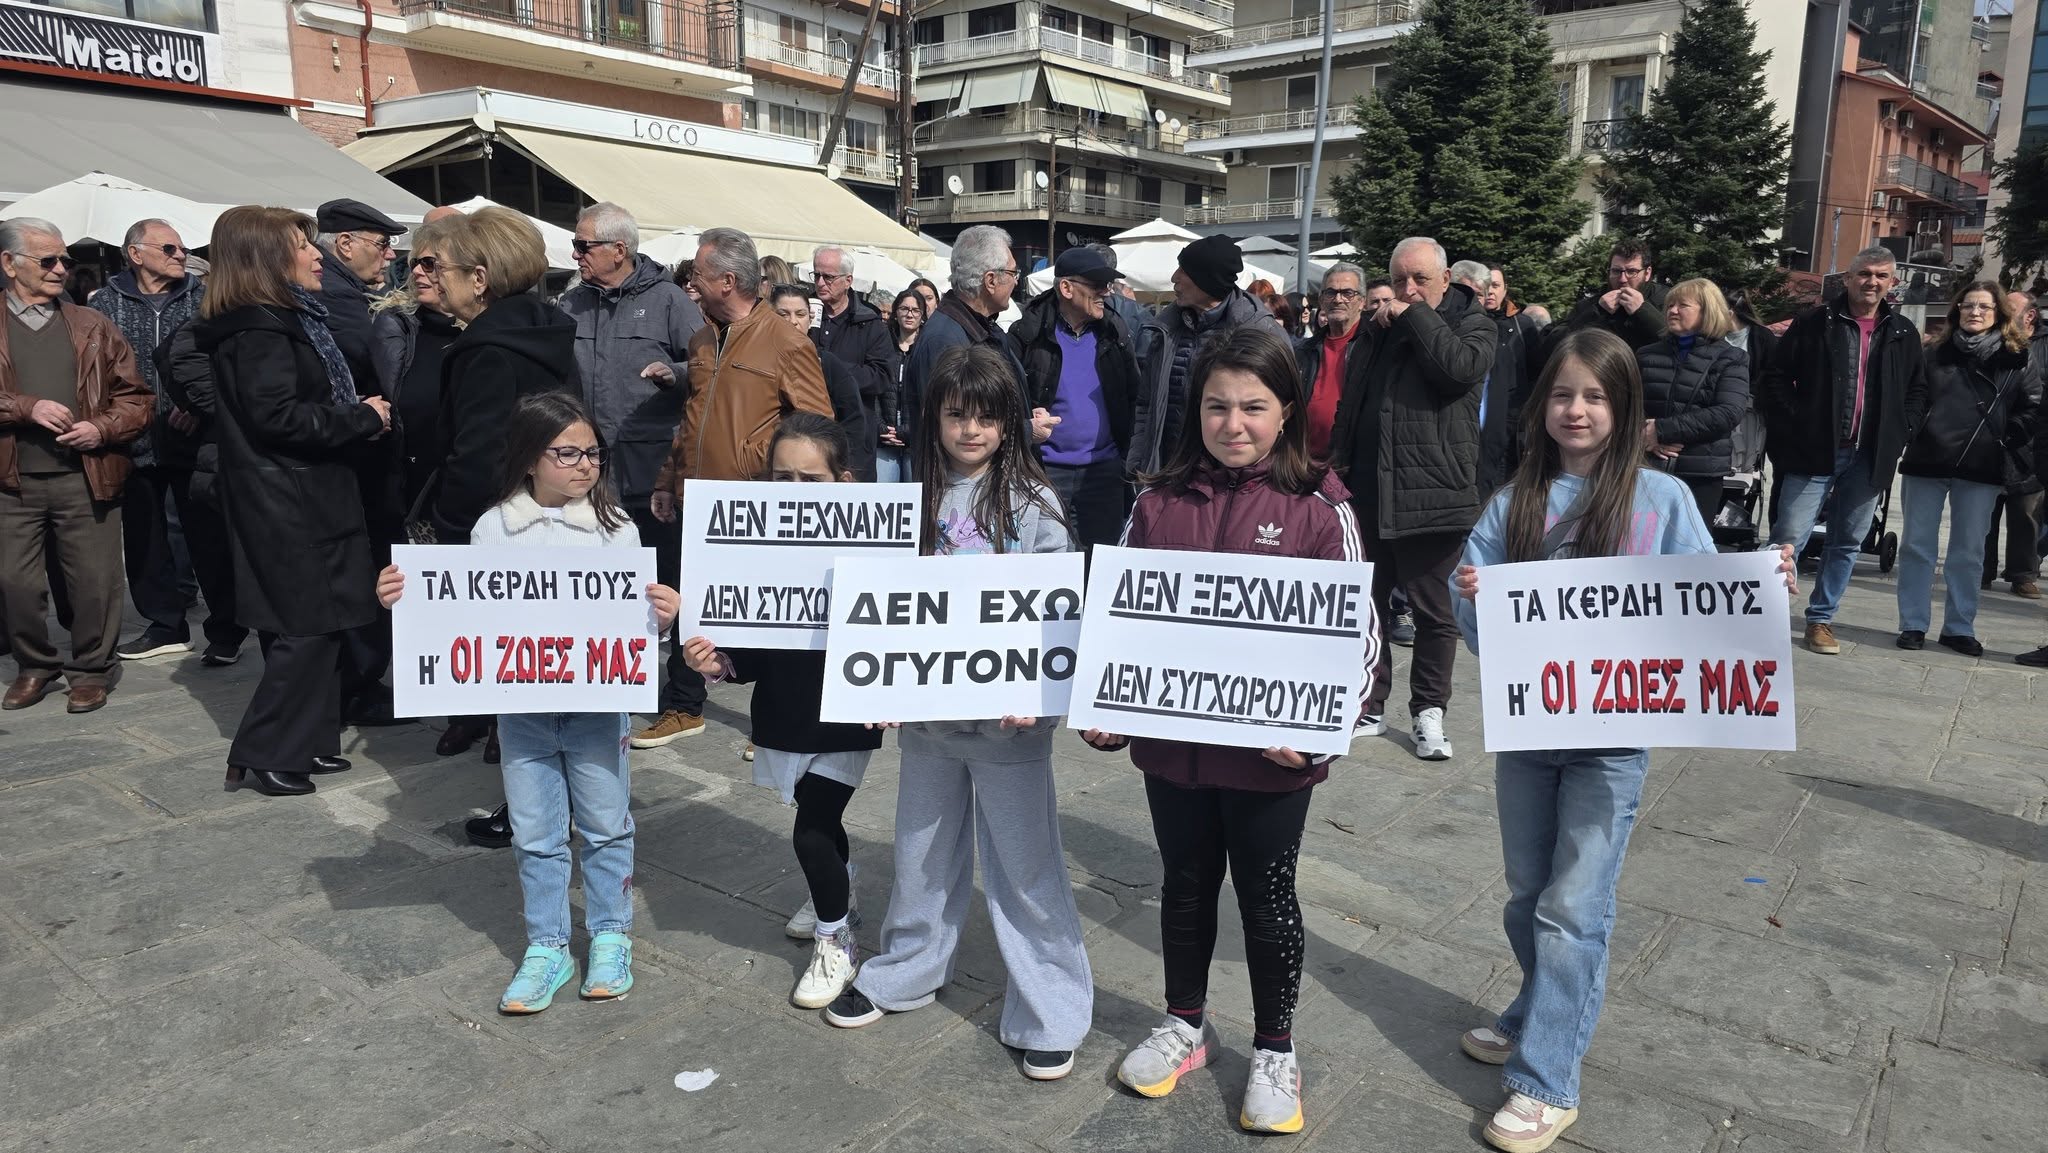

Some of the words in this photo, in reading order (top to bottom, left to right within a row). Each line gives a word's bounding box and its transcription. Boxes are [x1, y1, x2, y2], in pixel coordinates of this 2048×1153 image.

[62, 33, 200, 82] Maido
[633, 119, 698, 146] LOCO
[706, 500, 767, 537] ΔΕΝ
[777, 501, 914, 540] ΞΕΧΝΑΜΕ
[1254, 538, 1281, 546] adidas
[421, 570, 457, 600] ΤΑ
[568, 571, 638, 600] ΤΟΥΣ
[701, 584, 749, 619] ΔΕΝ
[756, 586, 832, 622] ΣΥΓΧΩ
[1110, 569, 1182, 613] ΔΕΝ
[1190, 573, 1361, 628] ΞΕΧΝΑΜΕ
[1507, 588, 1547, 623] ΤΑ
[1674, 580, 1763, 615] ΤΟΥΣ
[846, 591, 949, 625] ΔΕΝ
[980, 588, 1081, 623] ΕΧΩ
[451, 636, 482, 684] ΟΙ
[496, 636, 575, 684] ΖΩΕΣ
[586, 637, 647, 685] ΜΑΣ
[843, 646, 1077, 687] ΟΓΥΓΟΝΟ
[1095, 662, 1152, 705] ΔΕΝ
[1157, 668, 1348, 724] ΣΥΓΧΩΡΟΥΜΕ
[1541, 660, 1577, 715] ΟΙ
[1591, 659, 1686, 714] ΖΩΕΣ
[1699, 659, 1780, 717] ΜΑΣ
